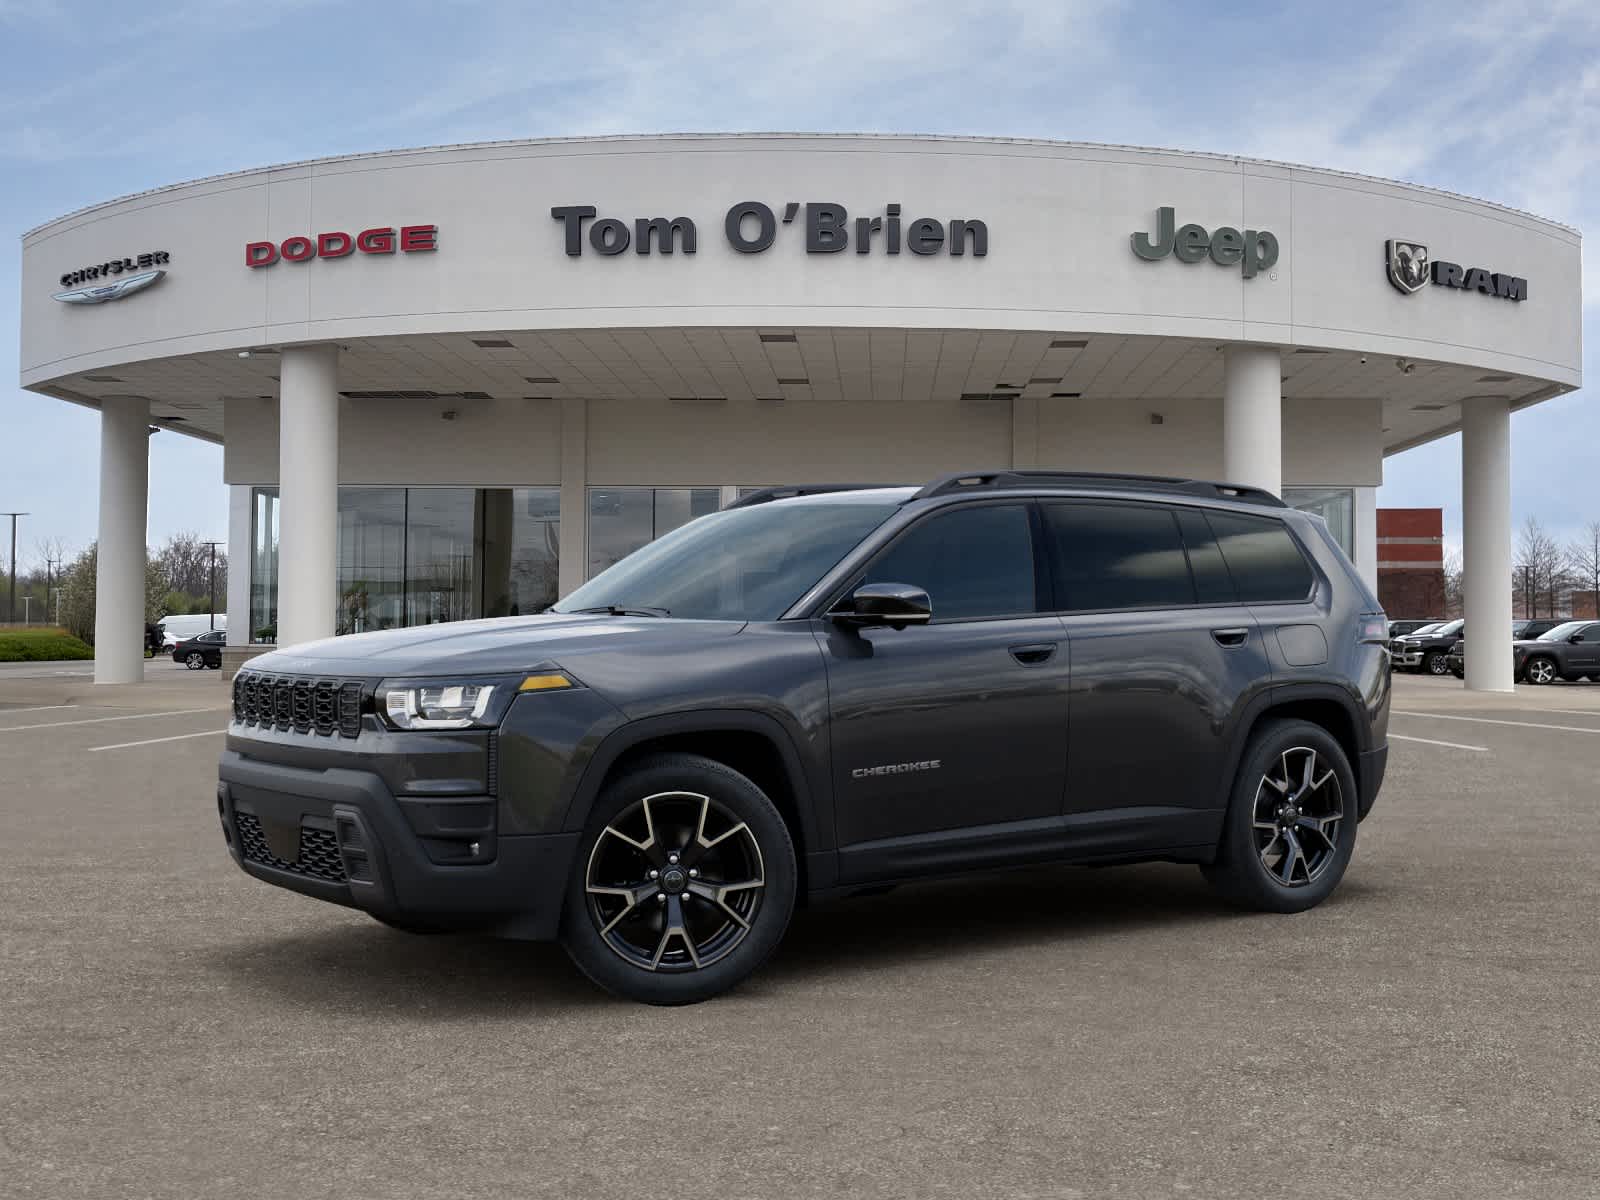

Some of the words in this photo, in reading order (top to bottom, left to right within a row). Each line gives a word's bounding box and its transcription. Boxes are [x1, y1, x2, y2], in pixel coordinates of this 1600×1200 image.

[245, 225, 437, 268] DODGE
[551, 205, 697, 257] Tom
[724, 201, 988, 256] O'Brien
[1130, 206, 1279, 279] Jeep
[60, 250, 170, 287] CHRYSLER
[1431, 261, 1528, 301] RAM
[852, 760, 941, 778] CHEROKEE
